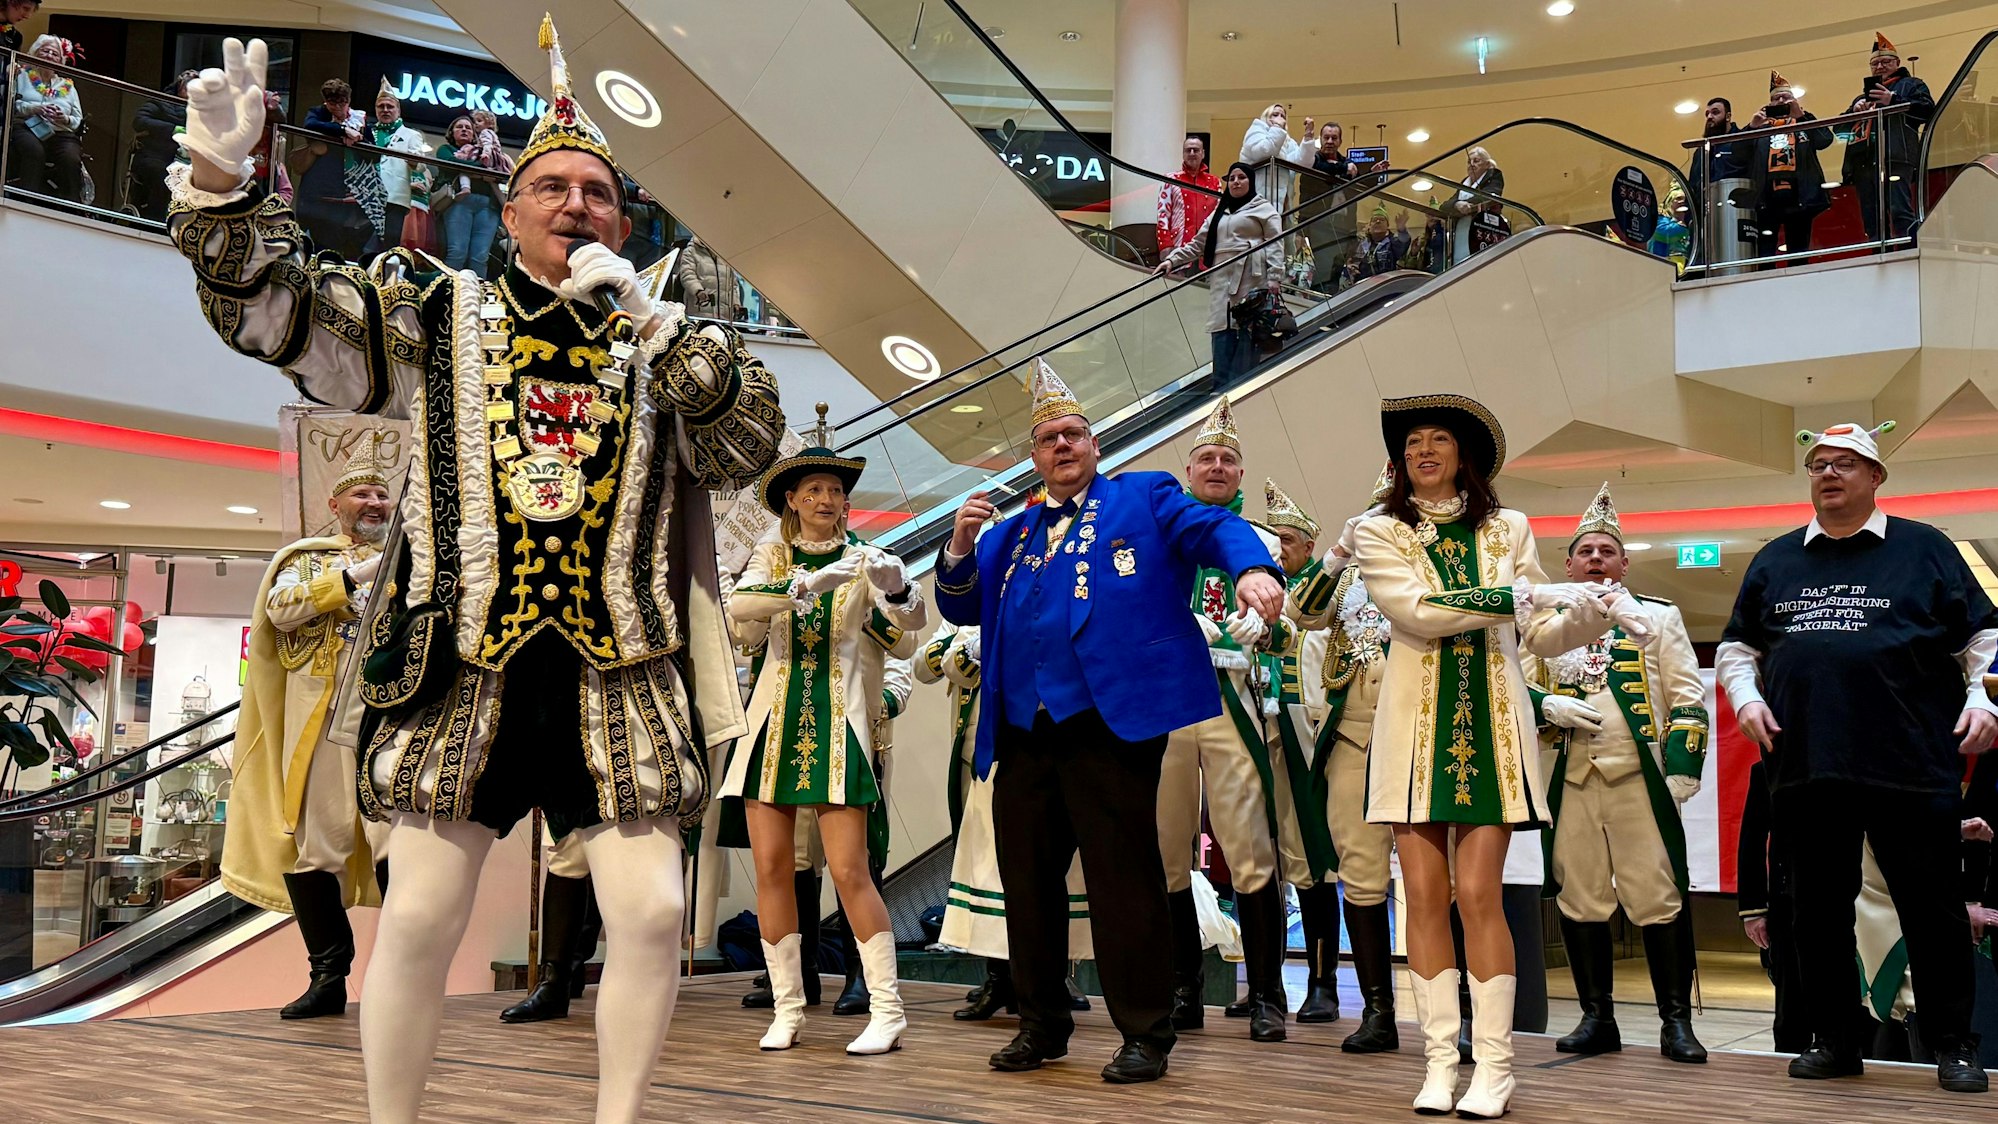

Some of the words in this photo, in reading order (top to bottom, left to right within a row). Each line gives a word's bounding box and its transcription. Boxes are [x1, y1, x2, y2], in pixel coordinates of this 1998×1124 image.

[735, 512, 759, 537] GARDE
[738, 501, 769, 532] PRINZEN
[722, 517, 756, 550] LEVERKUSEN
[1800, 587, 1828, 598] DAS
[1849, 585, 1868, 595] IN
[1833, 607, 1865, 620] FÜR
